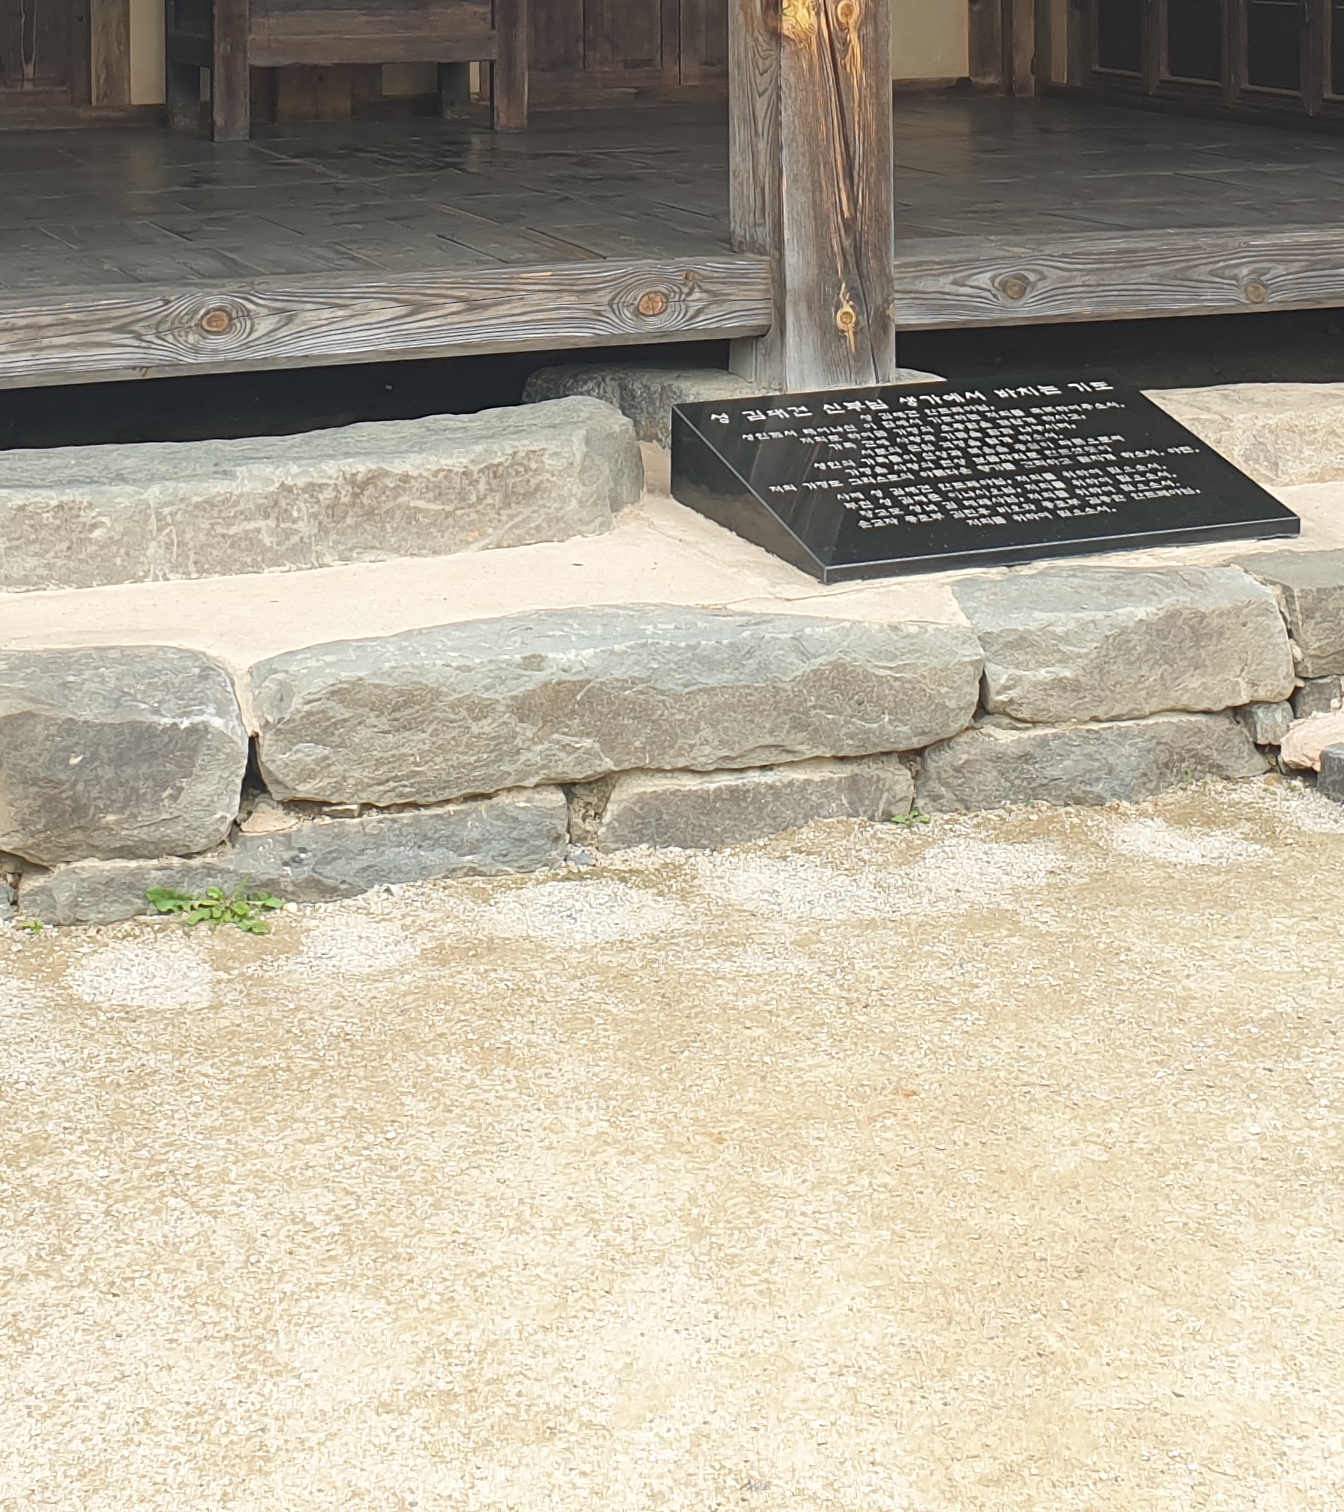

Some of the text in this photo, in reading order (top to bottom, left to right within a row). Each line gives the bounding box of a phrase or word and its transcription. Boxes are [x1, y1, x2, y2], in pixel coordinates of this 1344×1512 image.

[711, 381, 1115, 424] 성 김대건 신부님 생가에서 바치는 기도
